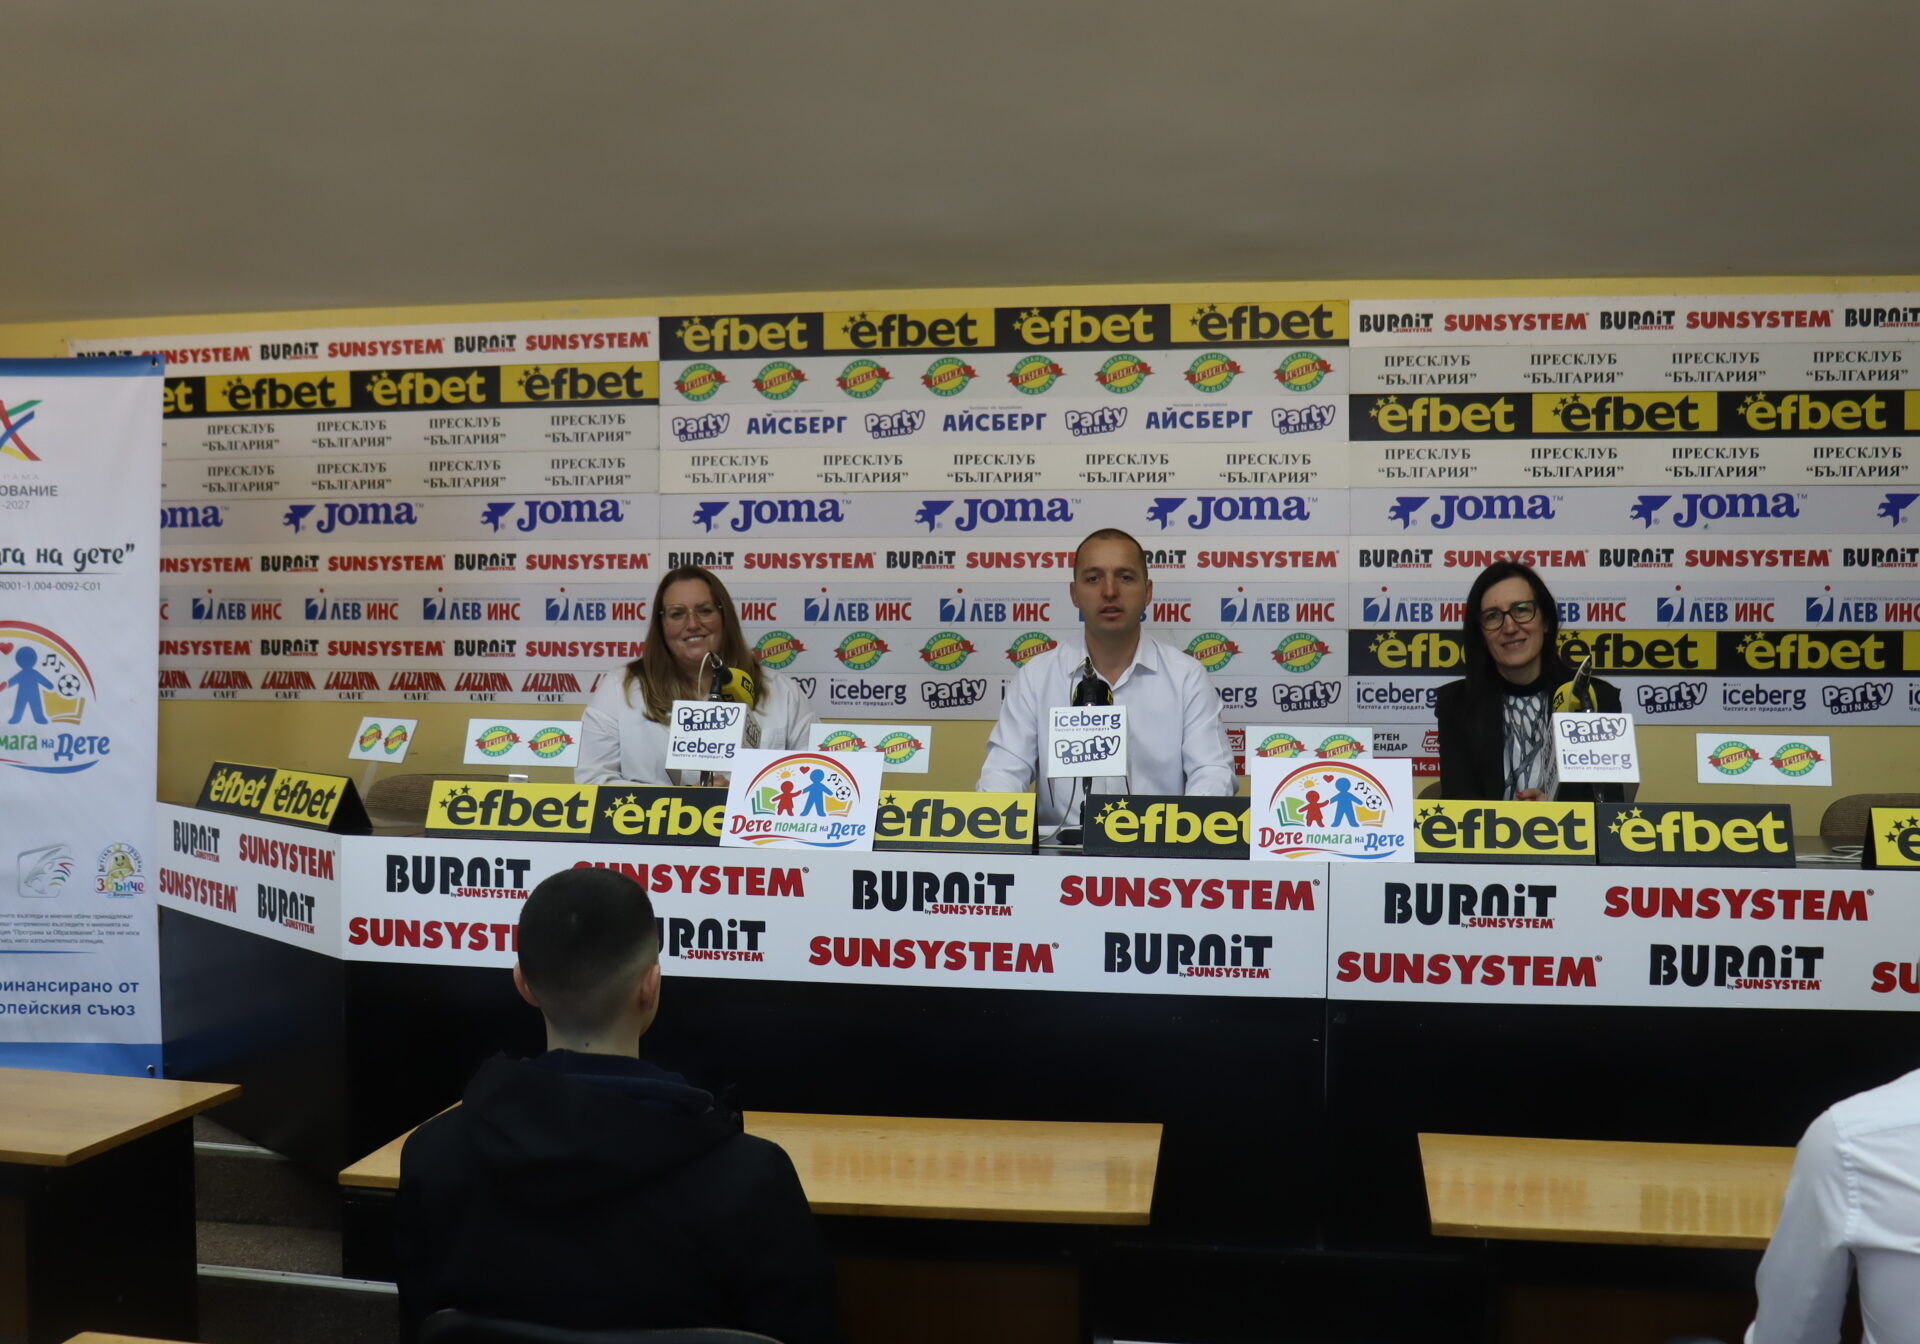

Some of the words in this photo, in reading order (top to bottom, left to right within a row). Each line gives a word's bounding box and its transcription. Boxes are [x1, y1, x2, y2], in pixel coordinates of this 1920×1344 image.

[684, 315, 809, 352] efbet
[849, 312, 978, 348] efbet
[1021, 307, 1154, 346] efbet
[1198, 303, 1334, 341] efbet
[328, 339, 443, 358] SUNSYSTEM
[1530, 353, 1618, 366] ПРЕСКЛУБ
[1671, 351, 1760, 365] ПРЕСКЛУБ
[1813, 350, 1902, 364] ПРЕСКЛУБ
[1384, 354, 1471, 367] ПРЕСКЛУБ
[227, 376, 337, 411] efbet
[372, 369, 486, 407] efbet
[524, 365, 644, 401] efbet
[551, 413, 626, 427] ПРЕСКЛУБ
[747, 412, 848, 435] АЙСБЕРГ
[864, 409, 925, 433] Party
[943, 409, 1047, 433] АЙСБЕРГ
[1064, 406, 1128, 430] Party
[1145, 407, 1253, 430] АЙСБЕРГ
[1271, 404, 1336, 428] Party
[1377, 396, 1515, 433] efbet
[1560, 394, 1700, 432] efbet
[1745, 393, 1887, 431] efbet
[207, 423, 275, 436] ПРЕСКЛУБ
[672, 413, 730, 437] Party
[691, 455, 769, 467] ПРЕСКЛУБ
[823, 454, 903, 467] ПРЕСКЛУБ
[1226, 453, 1311, 466] ПРЕСКЛУБ
[36, 548, 63, 566] на
[449, 602, 482, 620] ЛЕВ
[487, 602, 521, 620] ИНС
[833, 602, 869, 621] ЛЕВ
[875, 602, 912, 621] ИНС
[1252, 603, 1290, 622] ЛЕВ
[1296, 603, 1335, 622] ИНС
[1689, 602, 1728, 622] ЛЕВ
[1734, 602, 1775, 622] ИНС
[1744, 633, 1886, 670] efbet
[830, 677, 907, 705] iceberg
[921, 678, 987, 704] Party
[1272, 681, 1341, 705] Party
[1356, 681, 1437, 708] iceberg
[1637, 682, 1707, 708] Party
[1723, 683, 1806, 711] iceberg
[1822, 682, 1893, 709] Party
[928, 697, 974, 710] DRINKS
[1281, 699, 1327, 712] DRINKS
[1645, 700, 1693, 715] DRINKS
[1830, 701, 1880, 715] DRINKS
[678, 705, 740, 727] Party
[683, 720, 725, 732] DRINKS
[1054, 710, 1121, 730] iceberg
[1560, 717, 1627, 740] Party
[1569, 732, 1616, 745] DRINKS
[41, 739, 55, 749] на
[54, 733, 111, 762] Дете
[672, 736, 736, 759] iceberg
[1054, 735, 1121, 758] Party
[1062, 751, 1108, 765] DRINKS
[1562, 749, 1632, 770] iceberg
[209, 770, 267, 809] efbet
[273, 778, 337, 820] efbet
[446, 789, 589, 830] efbet
[612, 797, 727, 838] efbe
[875, 799, 1029, 840] efbet
[729, 814, 772, 835] Дете
[774, 820, 817, 833] помага
[827, 822, 866, 840] Дете
[1258, 826, 1303, 848] Дете
[1306, 832, 1352, 845] помага
[1364, 832, 1405, 851] Дете
[1421, 808, 1588, 851] efbet
[1619, 810, 1789, 853] efbet
[457, 887, 529, 899] SUNSYSTEM
[931, 903, 1014, 917] SUNSYSTEM
[348, 917, 519, 952] SUNSYST
[1468, 916, 1555, 930] SUNSYSTEM
[687, 949, 765, 962] SUNSYSTEM
[1186, 966, 1270, 979] SUNSYSTEM
[118, 981, 140, 993] от
[1734, 978, 1821, 991] SUNSYSTEM
[87, 1003, 136, 1016] съюз
